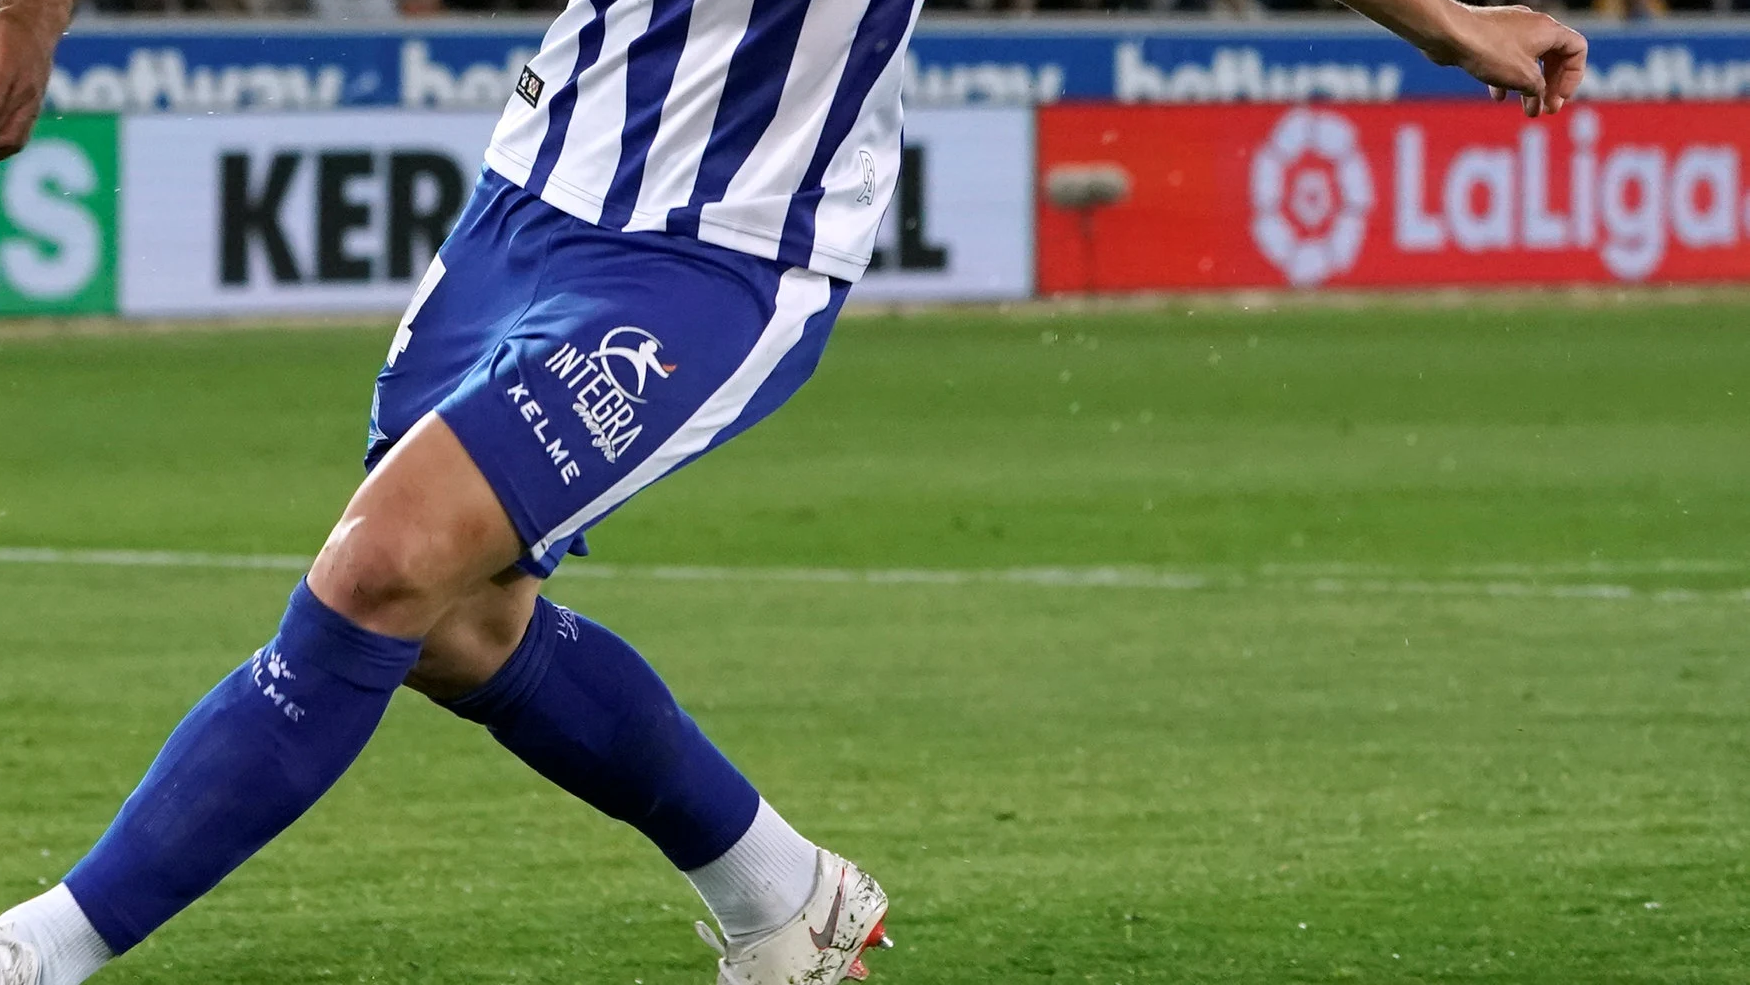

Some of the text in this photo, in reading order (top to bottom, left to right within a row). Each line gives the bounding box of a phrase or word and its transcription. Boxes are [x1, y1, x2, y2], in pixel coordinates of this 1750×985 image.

[1392, 108, 1750, 283] LaLiga
[507, 383, 581, 486] KELME
[545, 342, 643, 458] INTEGRA
